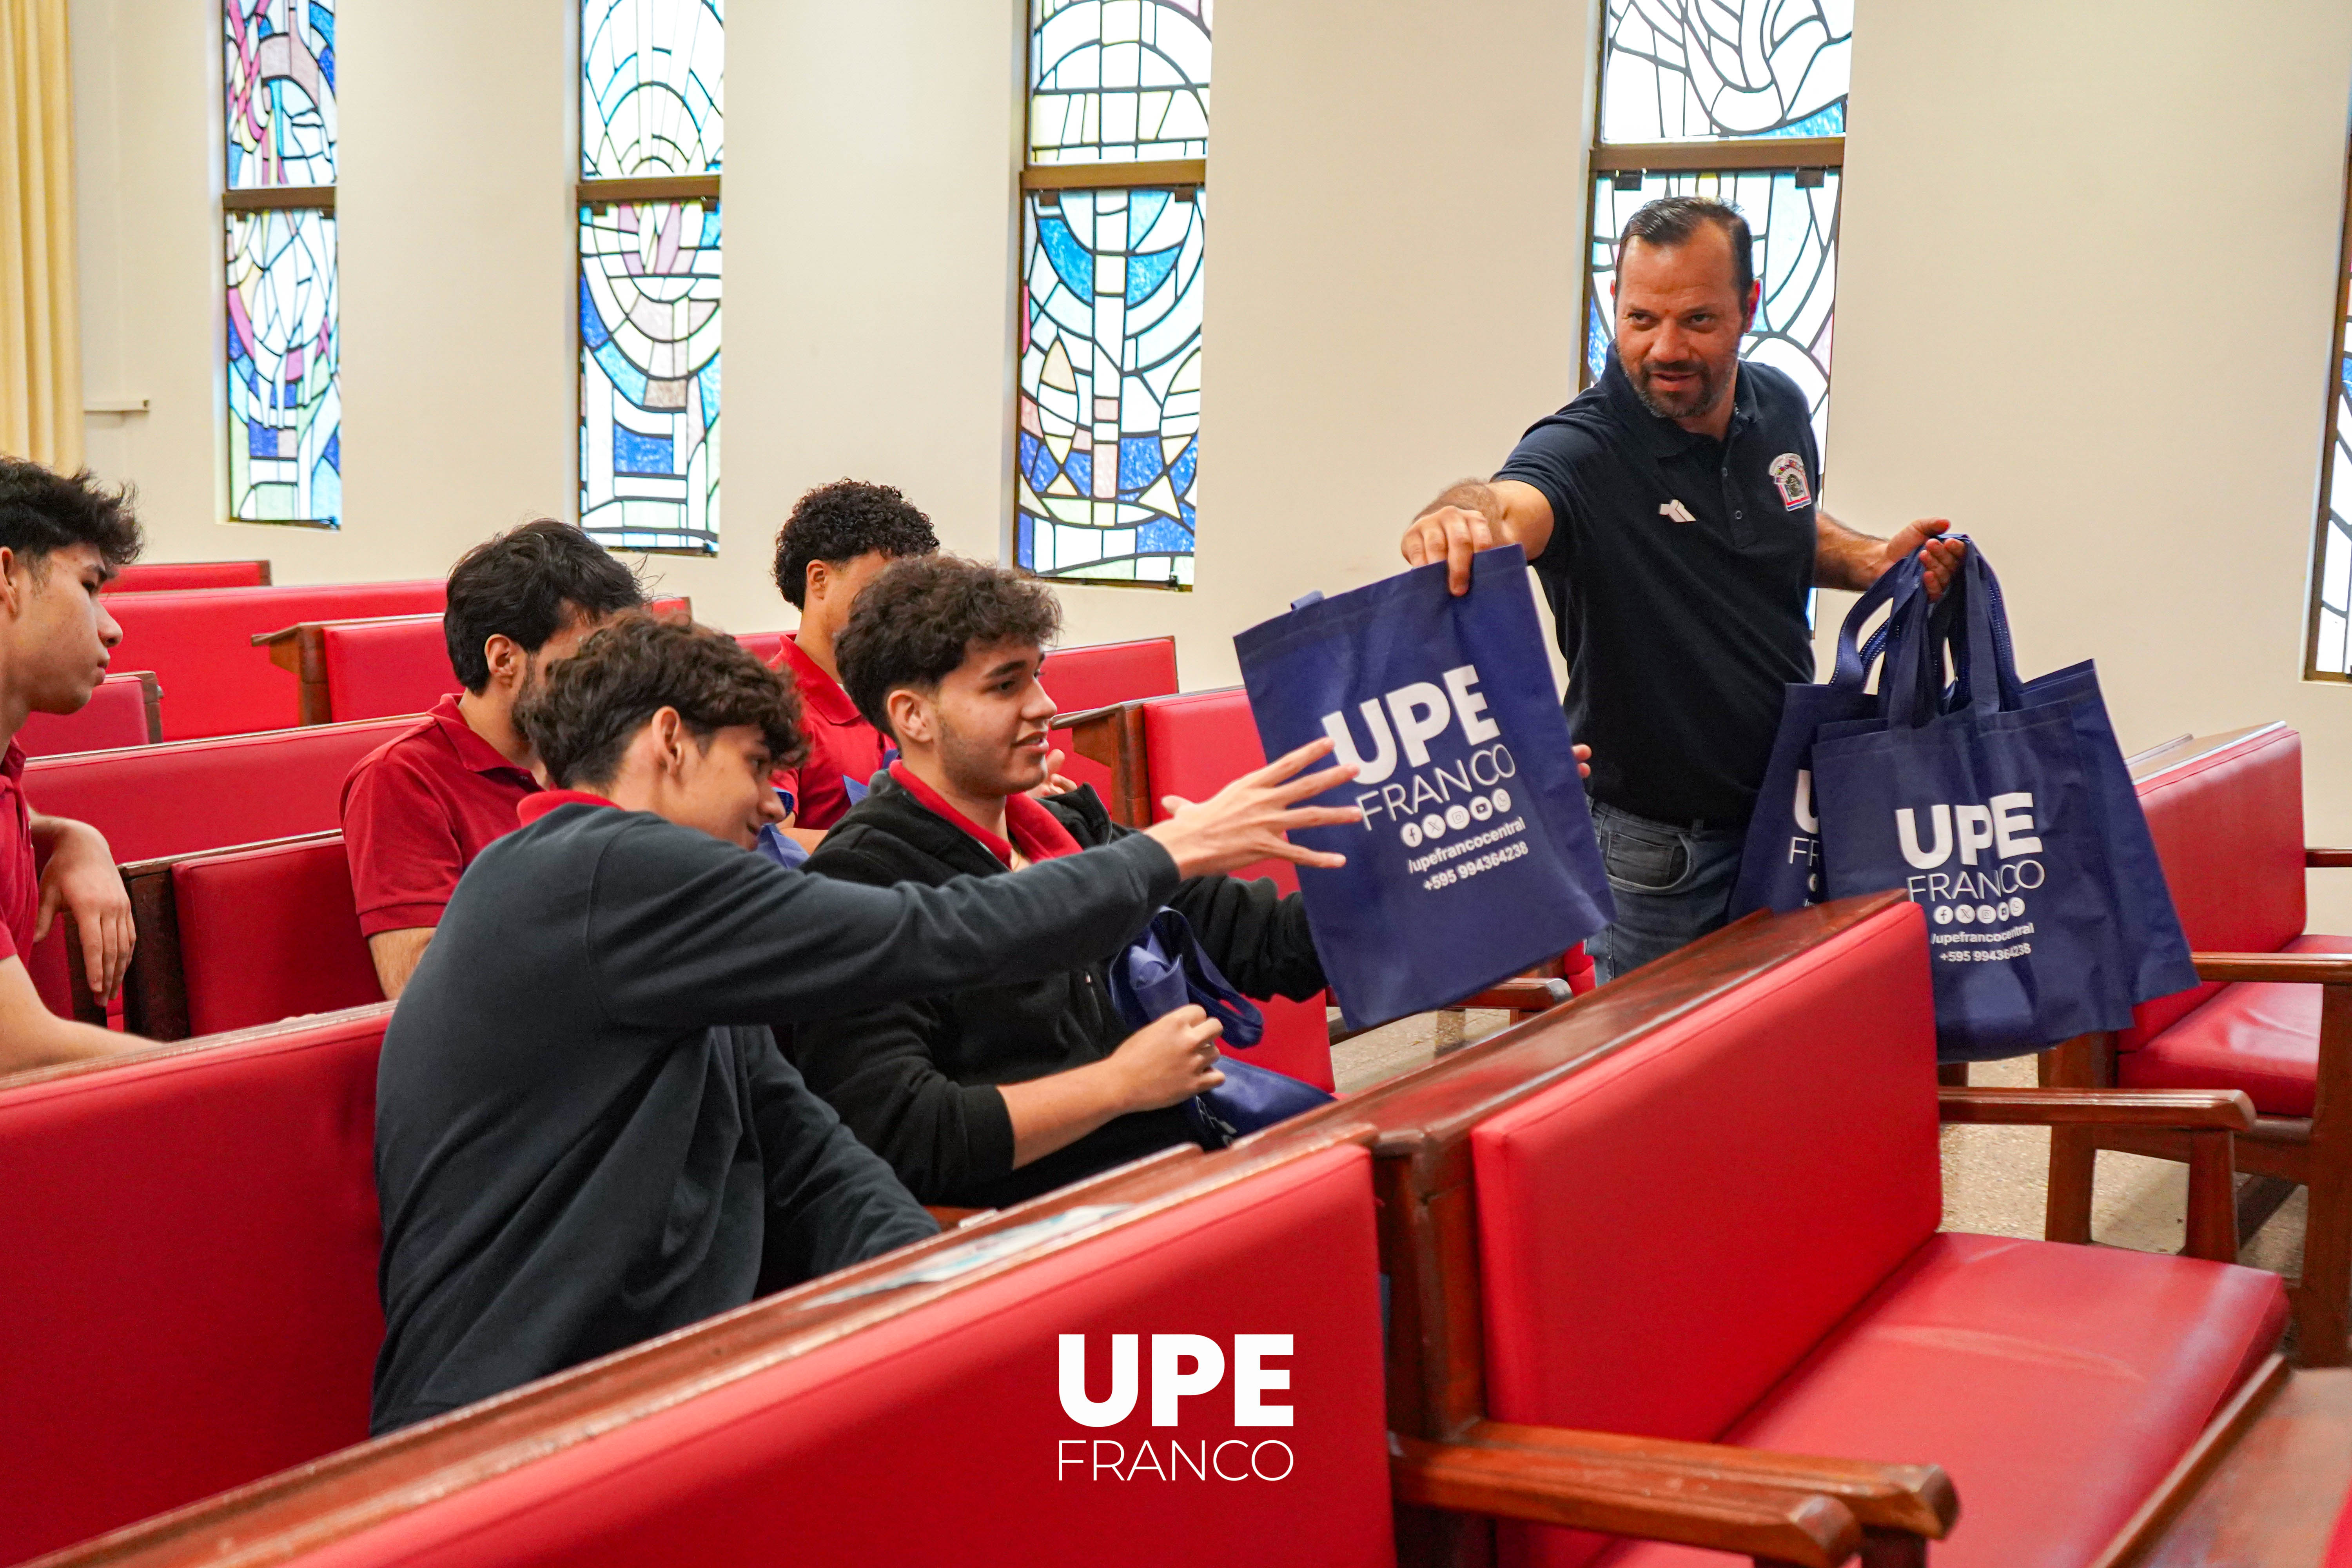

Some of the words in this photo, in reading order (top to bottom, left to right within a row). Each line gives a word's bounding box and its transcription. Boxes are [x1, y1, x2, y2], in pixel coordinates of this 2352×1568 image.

[1322, 664, 1501, 784] UPE
[1356, 744, 1515, 831] FRANCO
[1408, 816, 1526, 874] /upefrancocentral
[1895, 792, 2043, 869] UPE
[1423, 869, 1457, 890] +595
[1455, 840, 1528, 879] 994364238
[1907, 860, 2045, 902] FRANCO
[1931, 922, 2034, 946] /upefrancocentral
[1939, 951, 1971, 962] +595
[1973, 943, 2031, 962] 994364238
